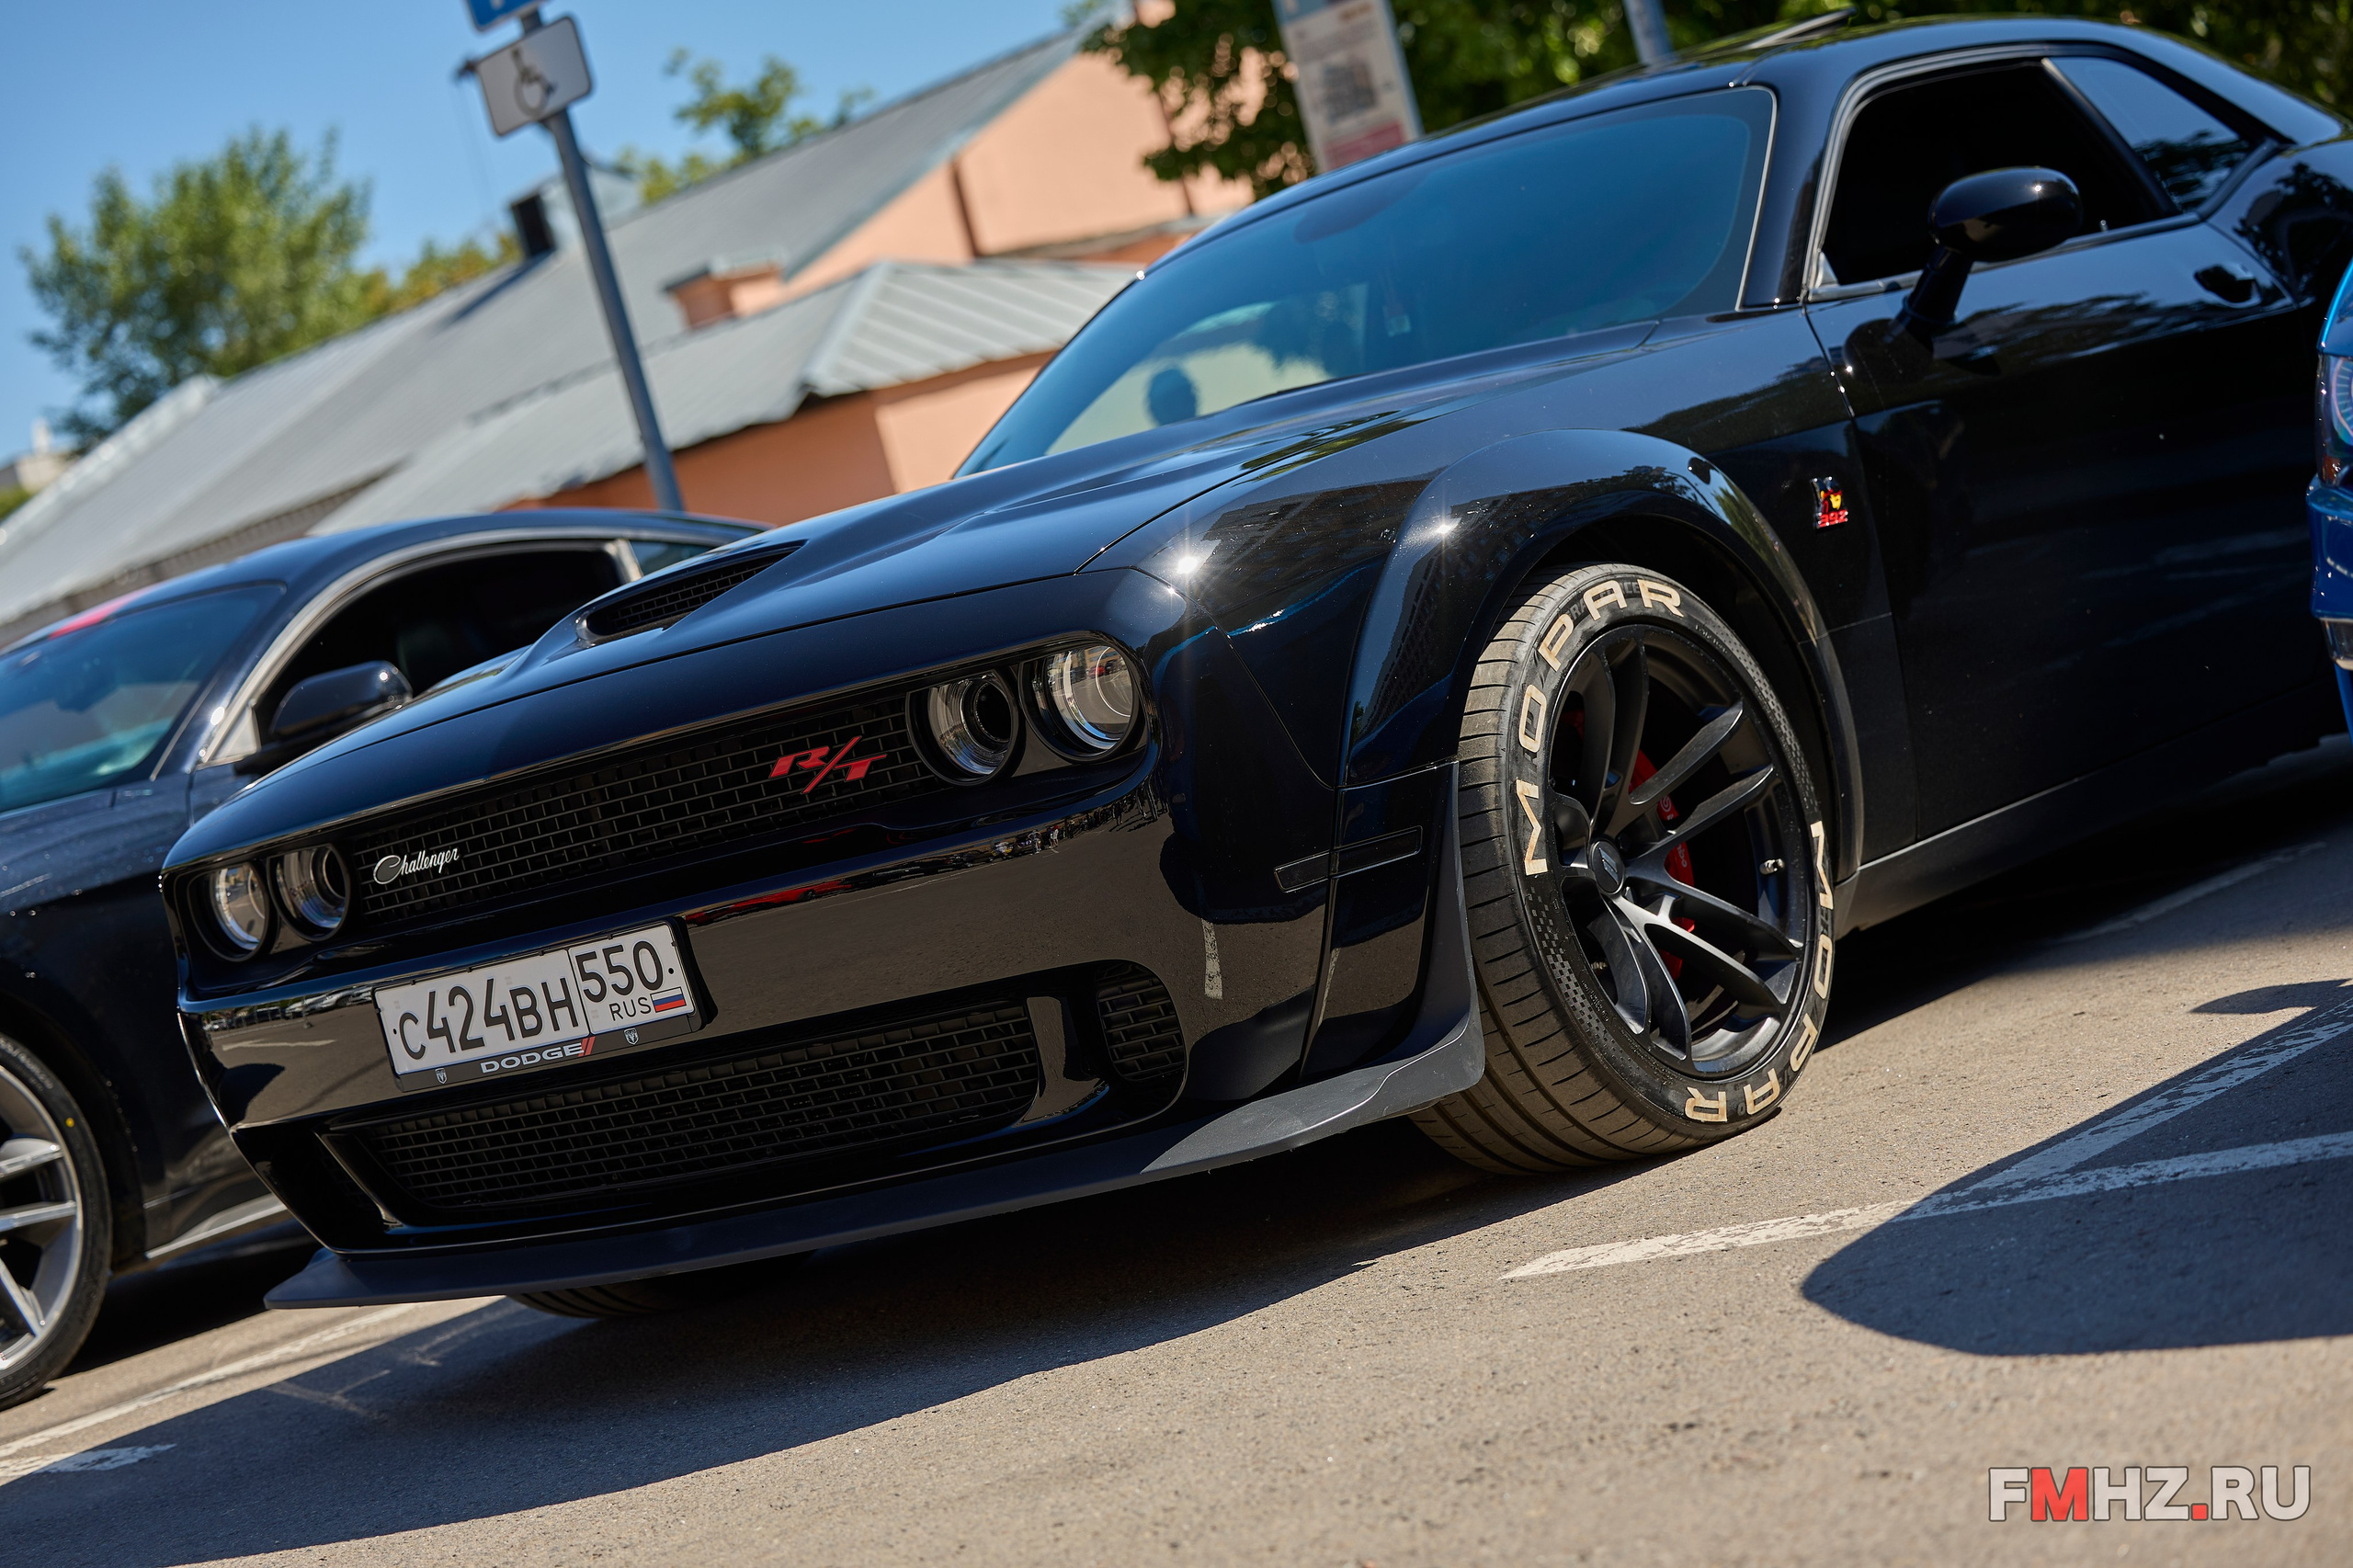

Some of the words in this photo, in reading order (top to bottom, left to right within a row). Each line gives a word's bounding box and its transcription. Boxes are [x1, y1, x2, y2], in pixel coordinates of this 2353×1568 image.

[1516, 578, 1684, 876] MOPAR
[770, 736, 886, 793] R/T
[373, 846, 459, 884] Challenger
[575, 941, 662, 1003] 550
[1684, 820, 1835, 1123] MOPAR
[610, 996, 651, 1021] RUS
[481, 1042, 585, 1074] DODGE
